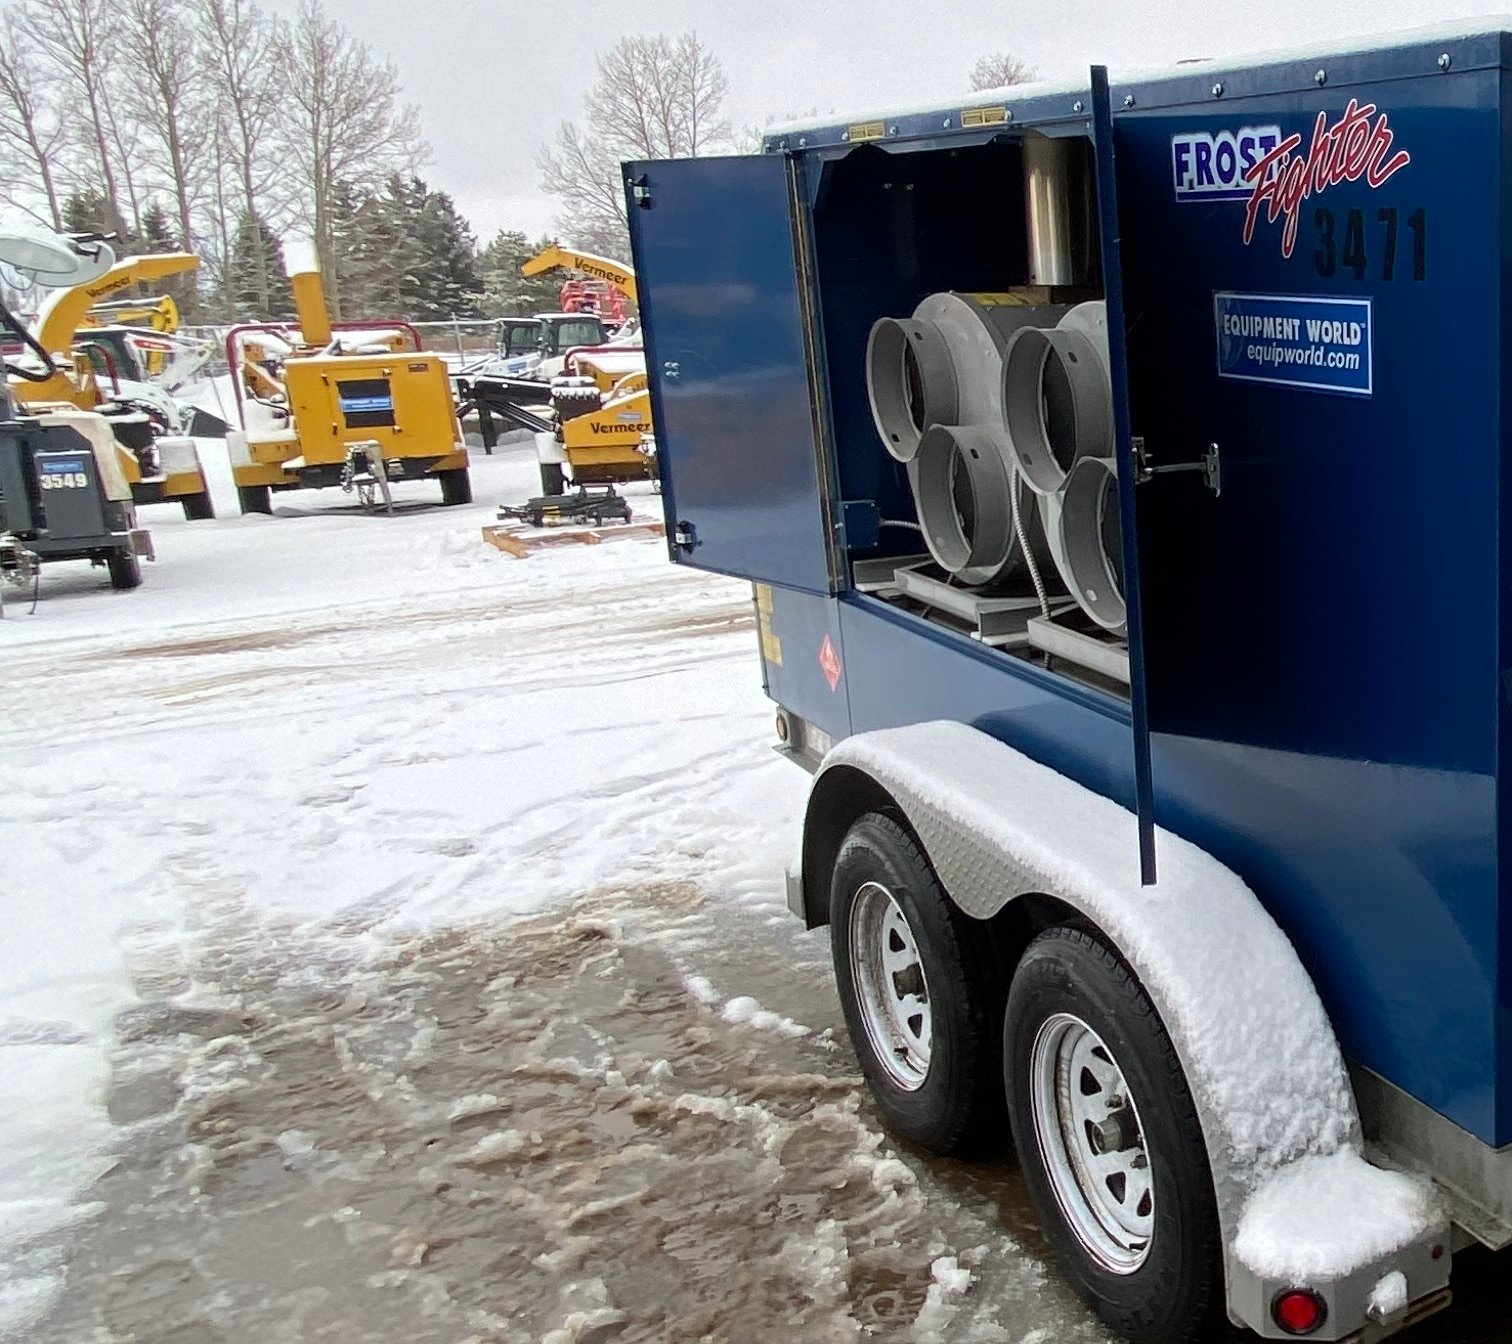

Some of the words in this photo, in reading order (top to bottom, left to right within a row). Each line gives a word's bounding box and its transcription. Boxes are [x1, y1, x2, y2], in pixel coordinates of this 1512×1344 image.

[1174, 134, 1277, 188] FROST
[1243, 98, 1411, 259] Fighter
[1312, 206, 1427, 282] 3471
[574, 257, 628, 286] Vermeer
[1223, 314, 1301, 341] EQUIPMENT
[1247, 341, 1360, 370] equipworld.com
[591, 422, 650, 434] Vermeer
[40, 472, 88, 490] 3549
